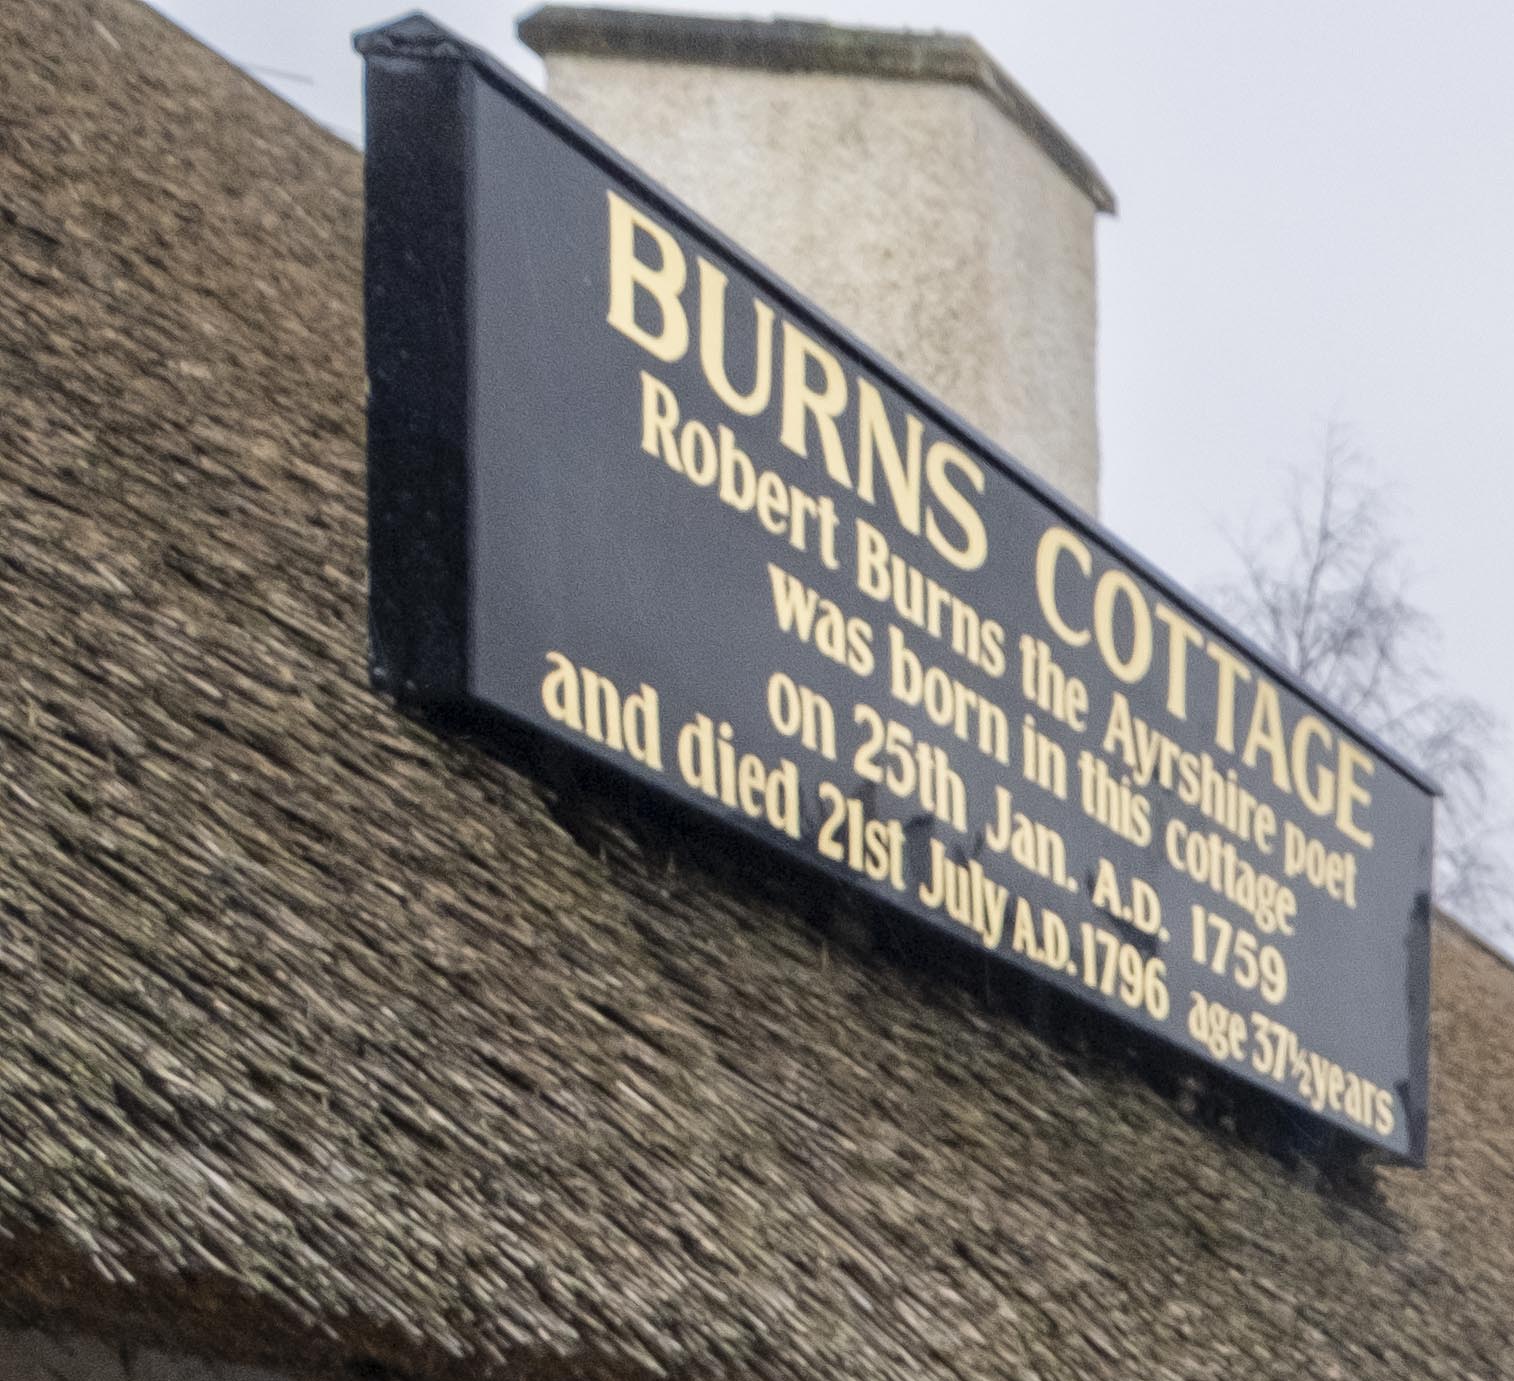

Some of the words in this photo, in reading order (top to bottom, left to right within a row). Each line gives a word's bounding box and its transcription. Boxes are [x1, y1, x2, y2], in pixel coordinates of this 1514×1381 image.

[606, 189, 988, 572] BURNS
[1035, 526, 1375, 850] COTTAGE
[640, 369, 840, 570] Robert
[855, 517, 1006, 678] Burns
[1018, 634, 1089, 732] the
[1103, 690, 1277, 855] Ayrshire
[1284, 819, 1357, 909] poet
[541, 650, 664, 772] and
[677, 712, 801, 841] died
[817, 780, 907, 891] 21st
[918, 838, 1009, 950] July
[1188, 989, 1249, 1062] age
[767, 562, 876, 677] was
[888, 624, 1009, 765] born
[1022, 713, 1068, 800] in
[1078, 750, 1152, 848] this
[1165, 818, 1297, 936] cottage
[767, 671, 837, 761] on
[853, 703, 967, 833] 25th
[985, 785, 1079, 893] Jan.
[1092, 857, 1171, 943] A.D.
[1190, 904, 1288, 1006] 1759
